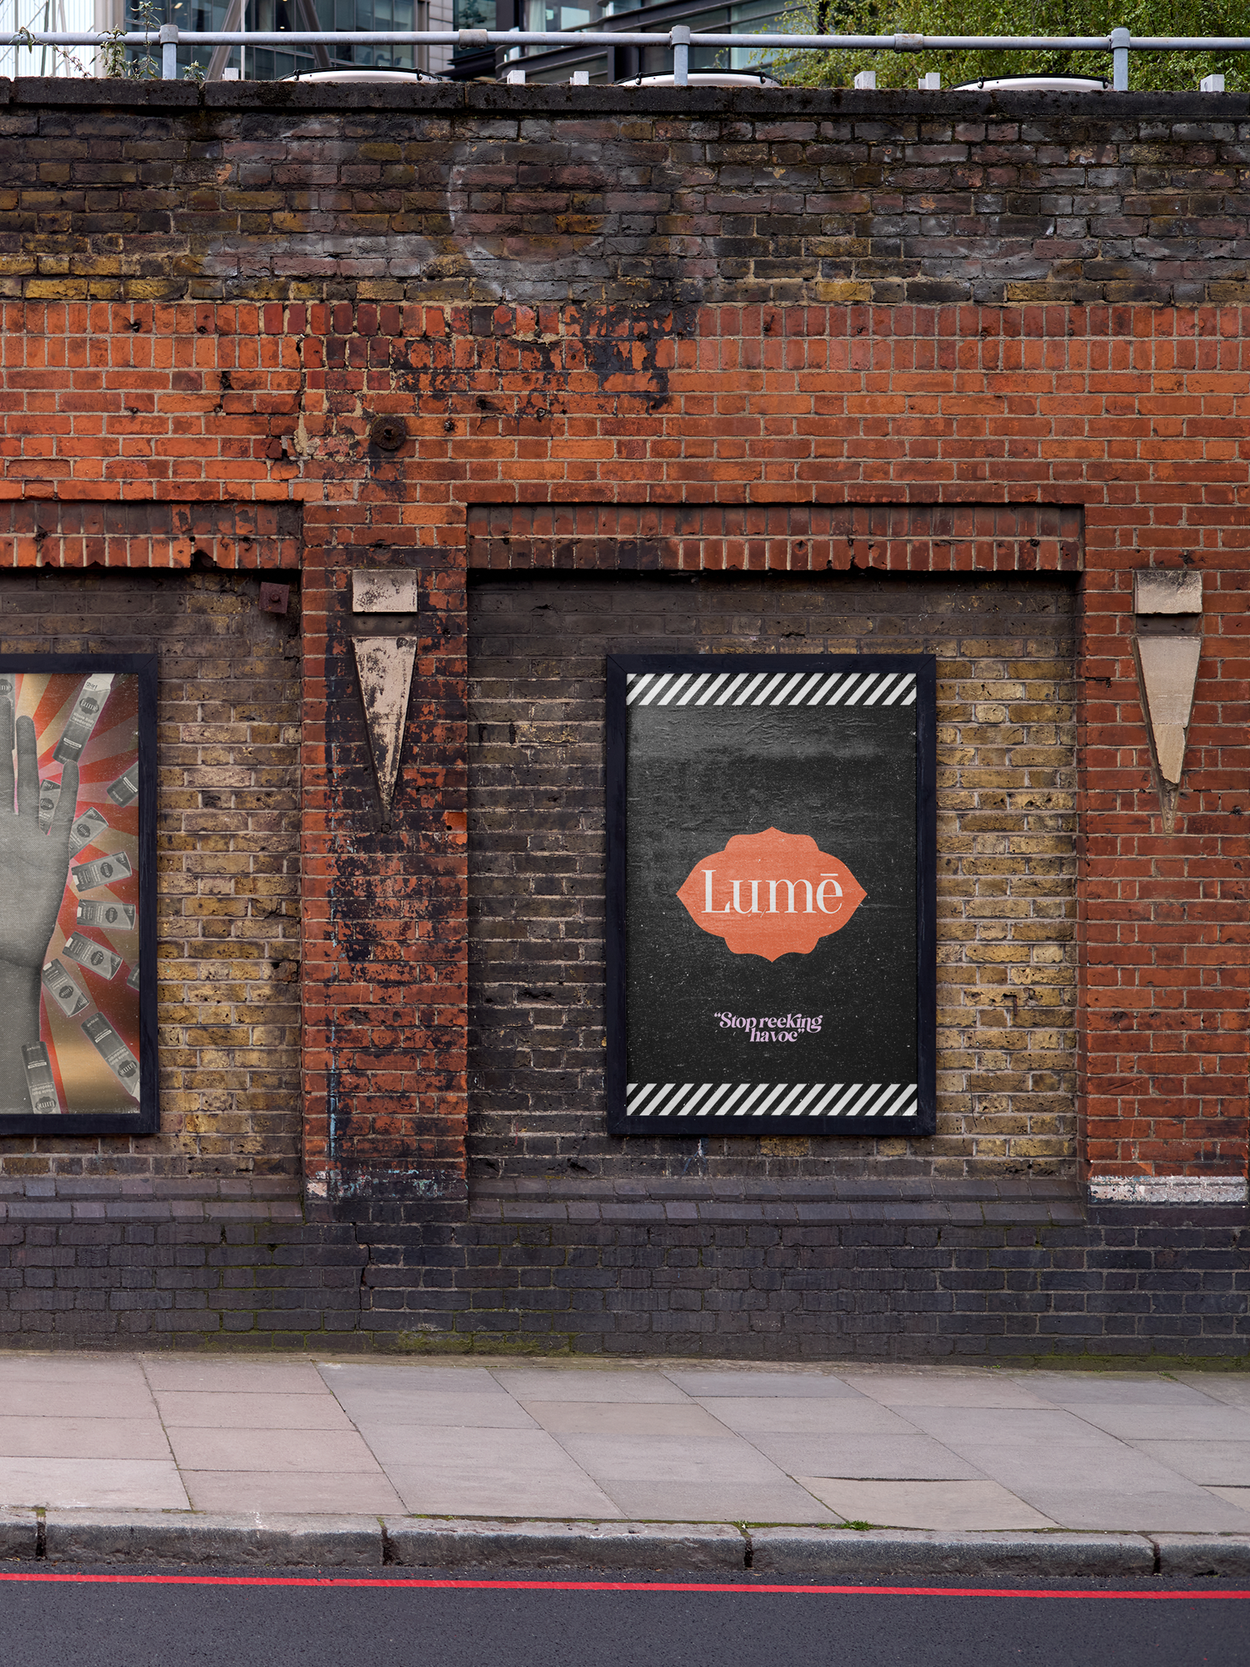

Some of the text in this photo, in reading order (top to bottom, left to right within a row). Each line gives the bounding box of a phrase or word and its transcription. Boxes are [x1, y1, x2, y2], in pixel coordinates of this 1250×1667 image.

[701, 869, 843, 915] Lumē
[714, 1011, 823, 1033] “Stop reeking
[750, 1028, 805, 1042] havoc”
